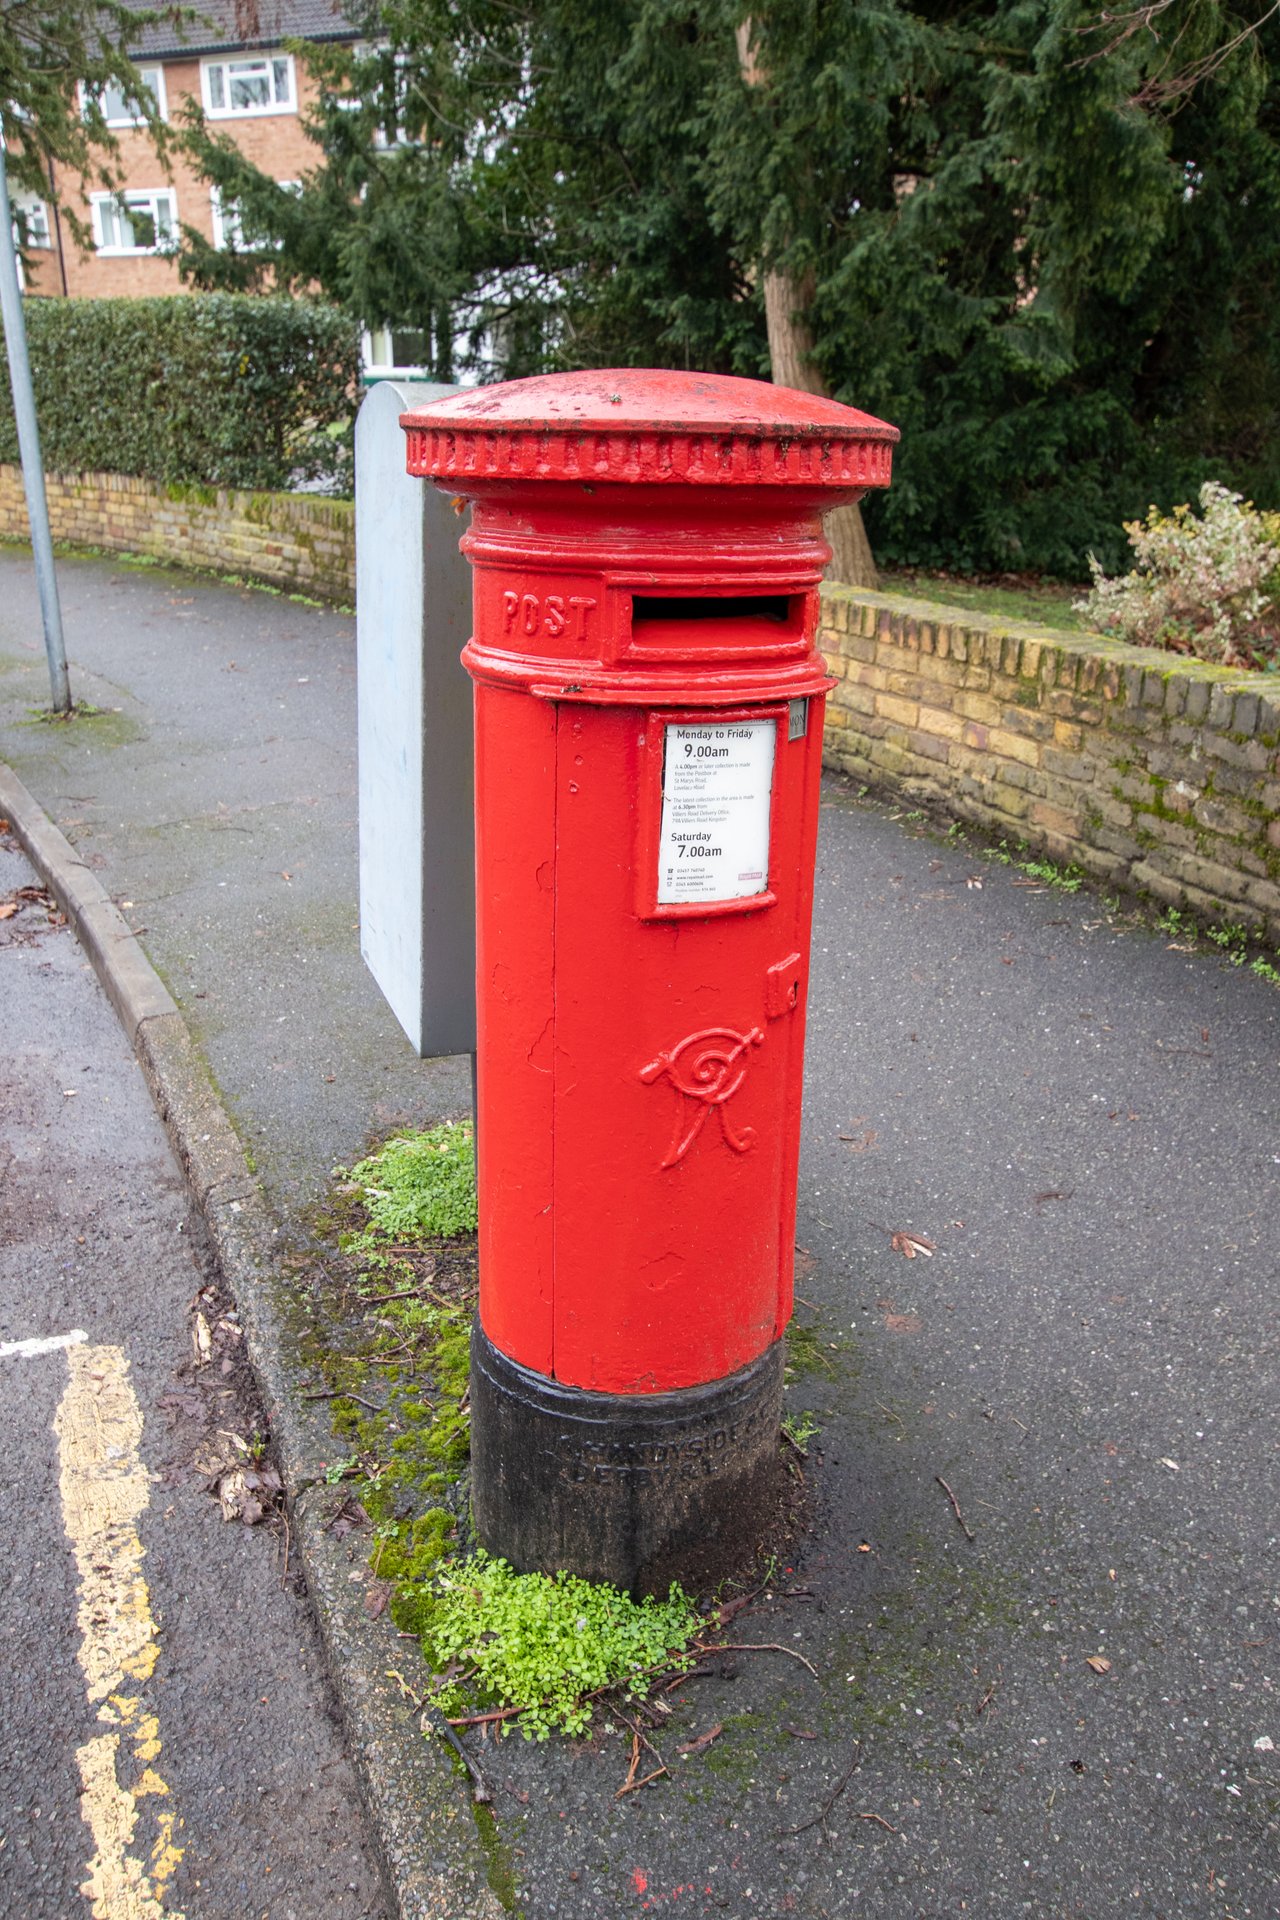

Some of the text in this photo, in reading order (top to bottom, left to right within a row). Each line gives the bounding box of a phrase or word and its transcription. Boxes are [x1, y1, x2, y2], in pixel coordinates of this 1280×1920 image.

[503, 591, 596, 640] POST
[677, 729, 753, 740] Monday to Friday
[684, 744, 729, 757] 9.00am
[671, 832, 712, 842] Saturday
[678, 845, 722, 858] 7.00am
